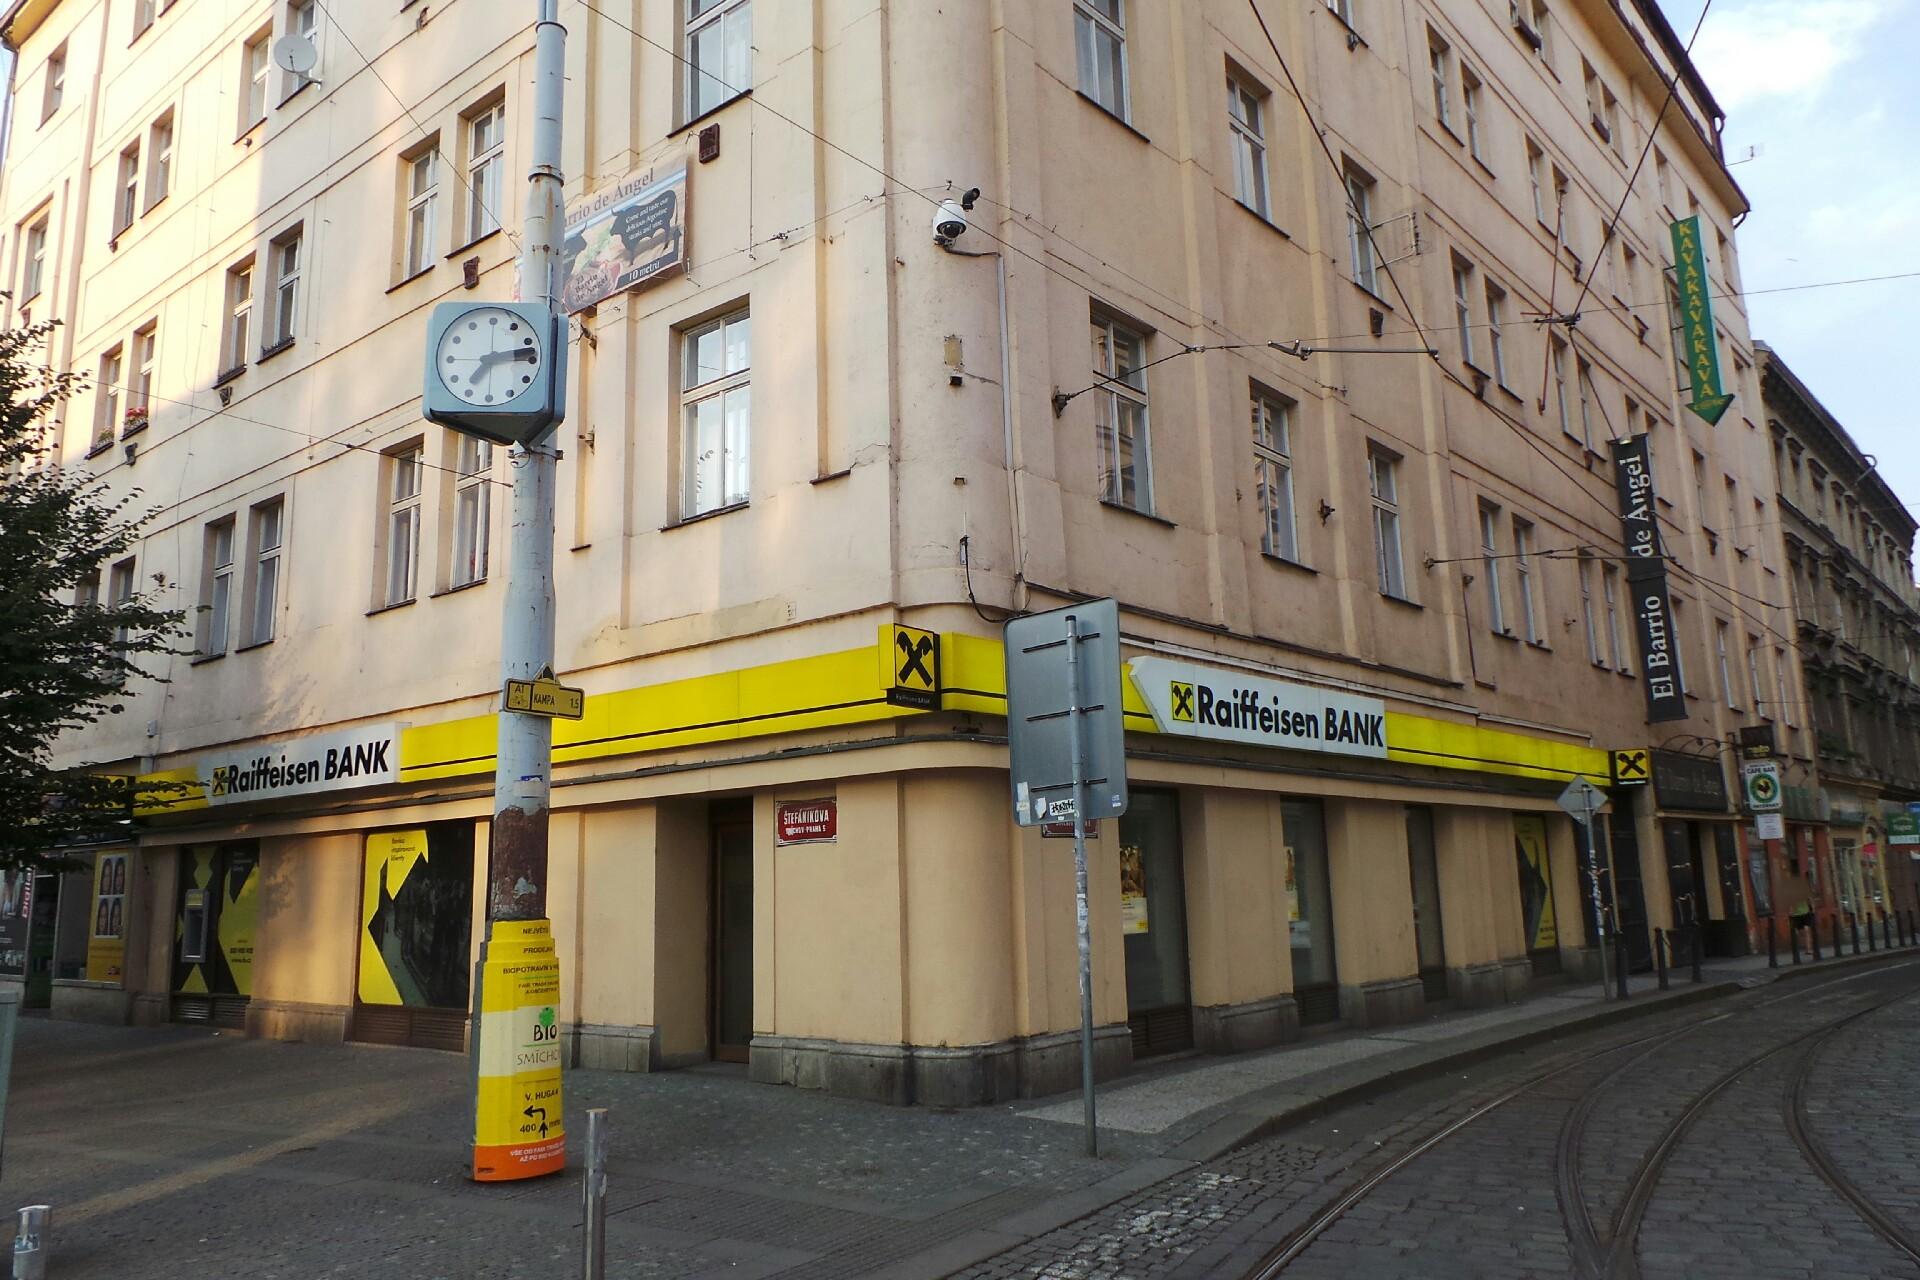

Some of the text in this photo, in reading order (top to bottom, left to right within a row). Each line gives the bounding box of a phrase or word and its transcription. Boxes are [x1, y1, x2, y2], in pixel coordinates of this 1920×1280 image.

[594, 193, 609, 211] de
[629, 269, 638, 281] 10
[1631, 529, 1653, 557] de
[1647, 595, 1670, 669] Barrio
[1650, 674, 1674, 700] El
[533, 693, 555, 706] KAMPA
[1197, 684, 1384, 748] Raiffeisen BANK
[227, 739, 391, 794] Raiffeisen BANK
[783, 808, 829, 825] ŠTEFÁNIKOVA
[806, 824, 821, 833] PRAHA
[822, 824, 826, 832] 5
[533, 1024, 557, 1042] BIO
[519, 1123, 537, 1133] 400
